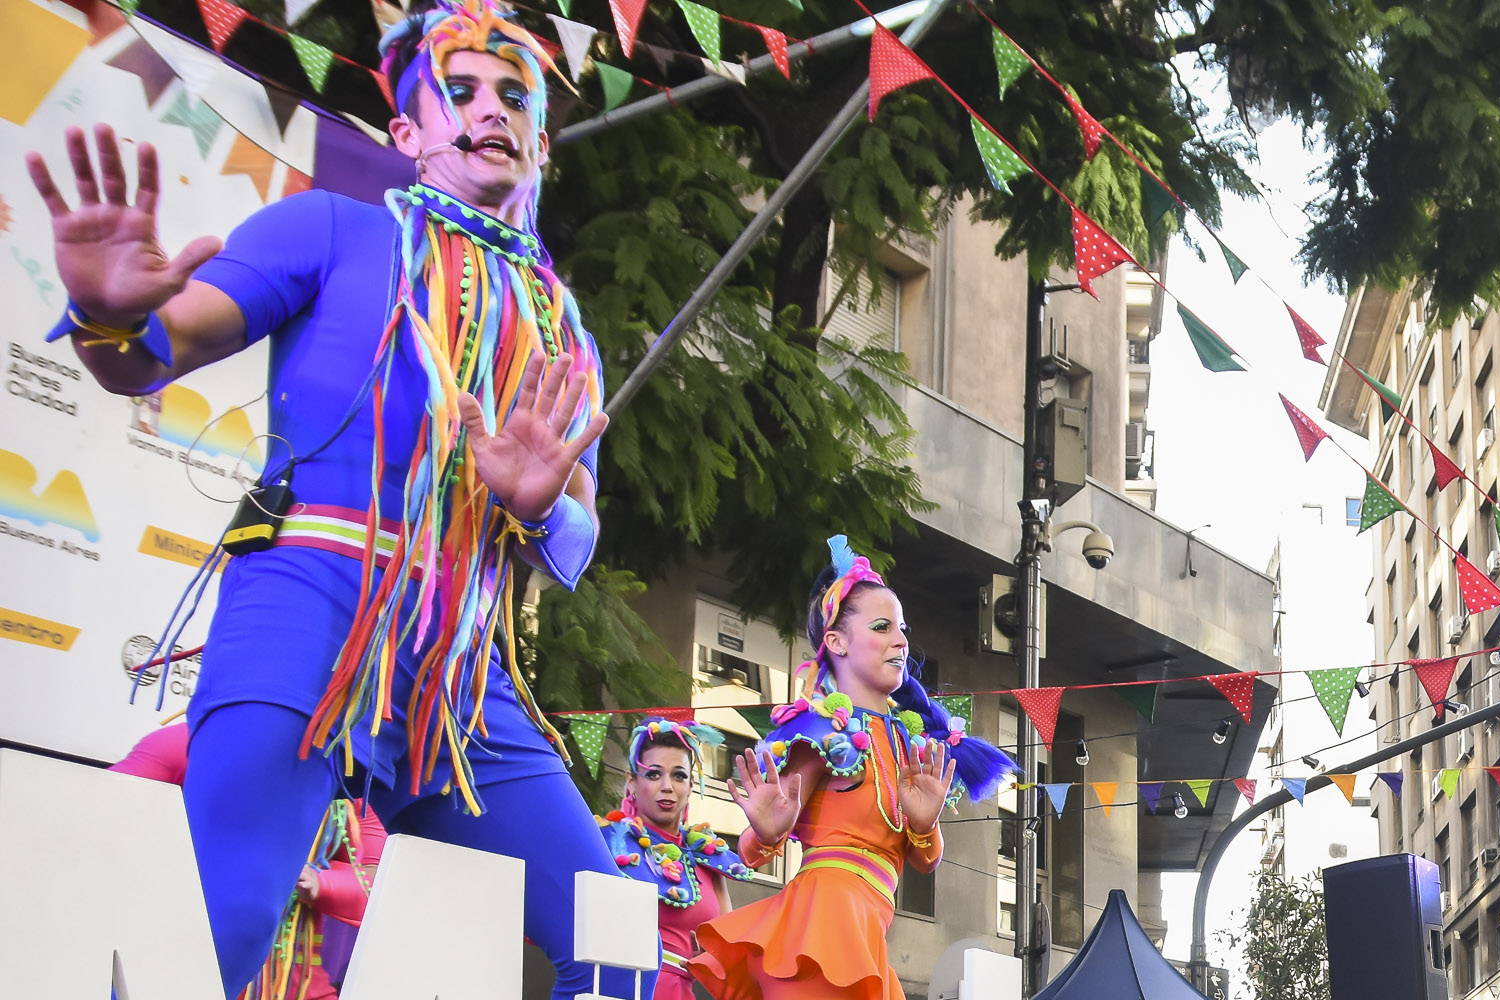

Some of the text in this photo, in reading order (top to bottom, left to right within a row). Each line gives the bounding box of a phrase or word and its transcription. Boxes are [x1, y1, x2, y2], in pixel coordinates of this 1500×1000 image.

[10, 341, 81, 381] Buenos
[8, 362, 62, 392] Aires
[7, 380, 78, 416] Ciudad
[178, 450, 226, 477] Buenos
[61, 540, 101, 562] Aires
